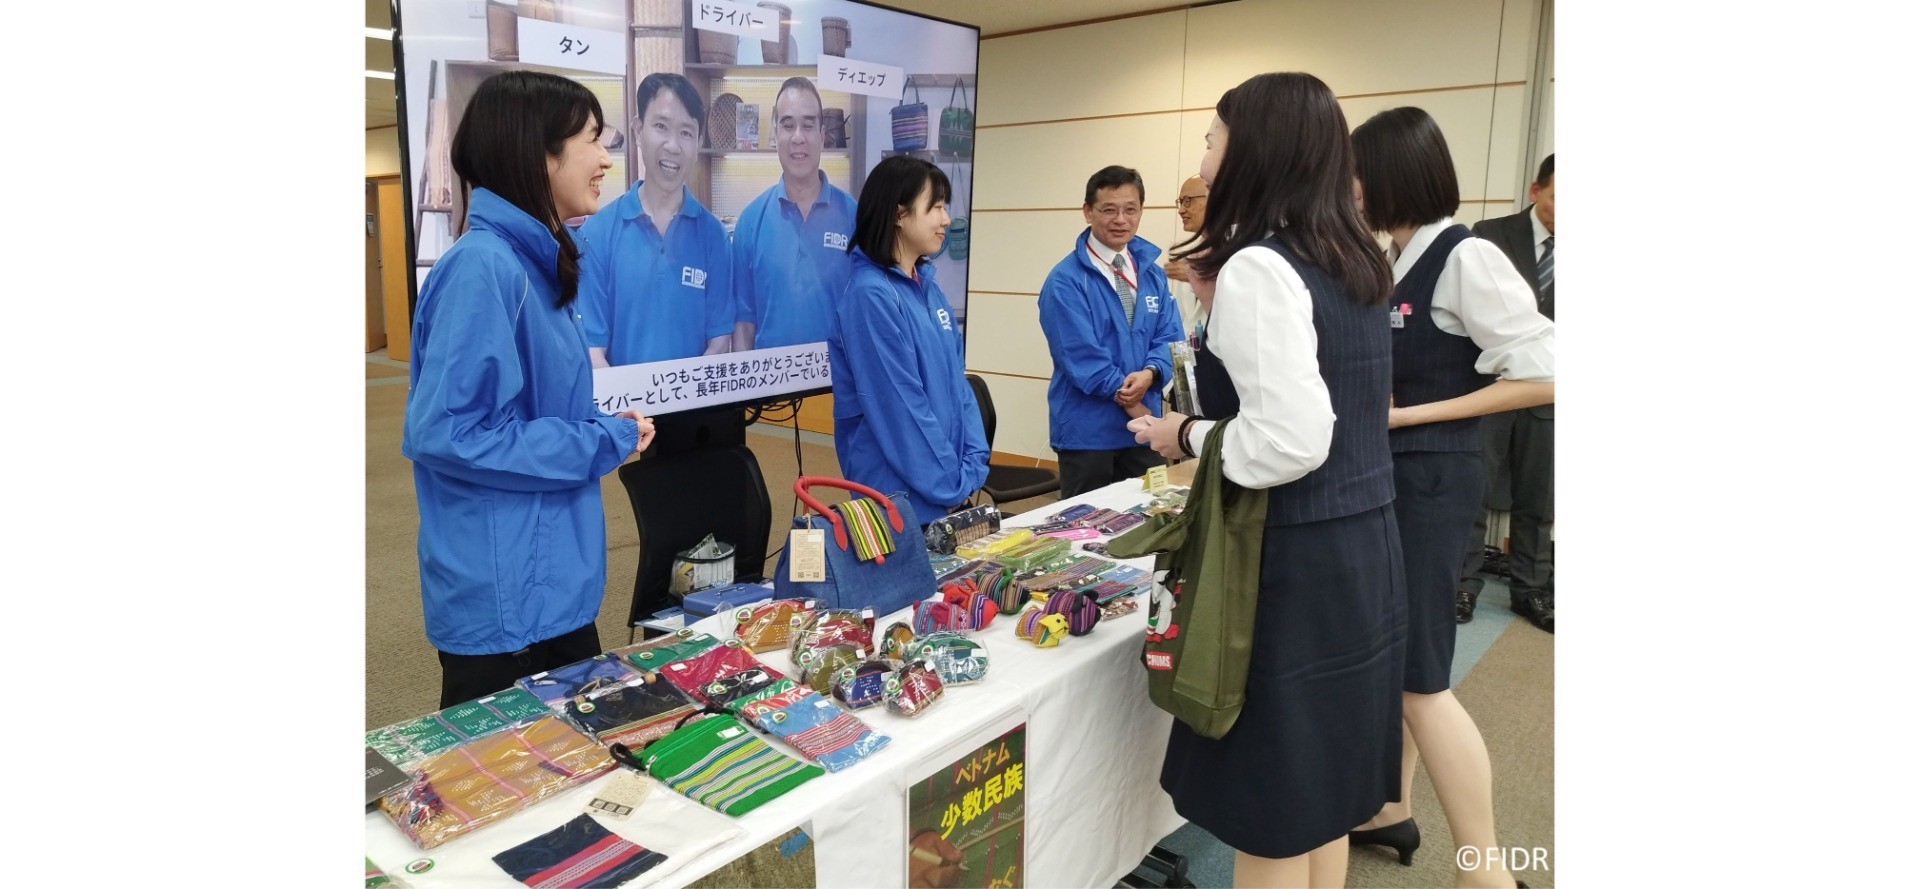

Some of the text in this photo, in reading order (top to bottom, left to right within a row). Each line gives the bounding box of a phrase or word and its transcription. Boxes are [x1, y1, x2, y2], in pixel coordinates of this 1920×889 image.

[700, 3, 764, 28] ドライバー
[558, 36, 590, 56] タン
[837, 66, 887, 87] ディエップ
[823, 231, 848, 248] FIDR
[955, 742, 1011, 785] ベトナム
[940, 762, 1024, 841] 少数民族
